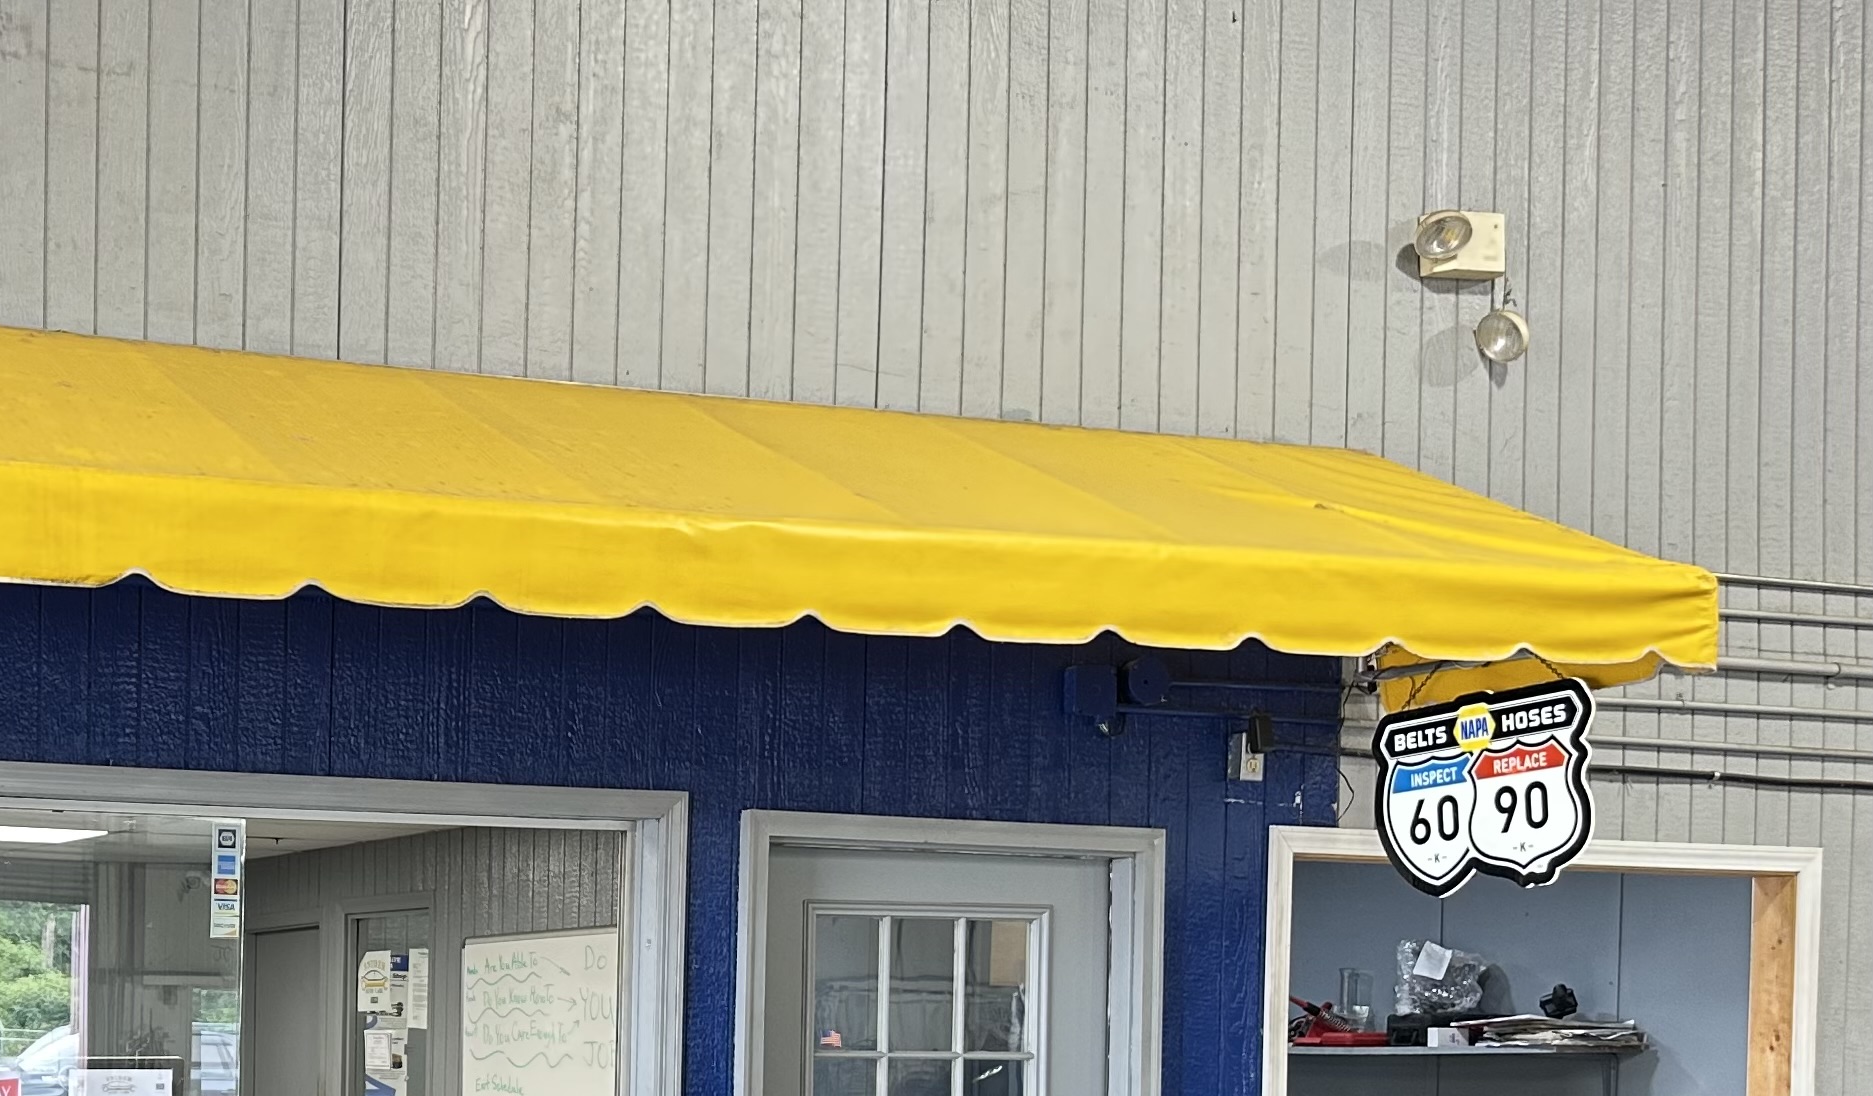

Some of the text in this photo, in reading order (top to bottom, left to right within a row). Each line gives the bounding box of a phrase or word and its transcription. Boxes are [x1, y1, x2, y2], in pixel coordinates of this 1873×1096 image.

[1393, 703, 1567, 752] BELTS NAPA HOSES
[1493, 751, 1547, 774] REPLACE
[1410, 767, 1458, 788] INSPECT
[1409, 794, 1459, 845] 60
[1494, 780, 1549, 834] 90
[484, 957, 497, 974] Are
[529, 951, 538, 969] To
[584, 944, 608, 971] Do
[579, 986, 615, 1027] YOU
[483, 1023, 494, 1045] Do
[495, 1024, 510, 1046] You
